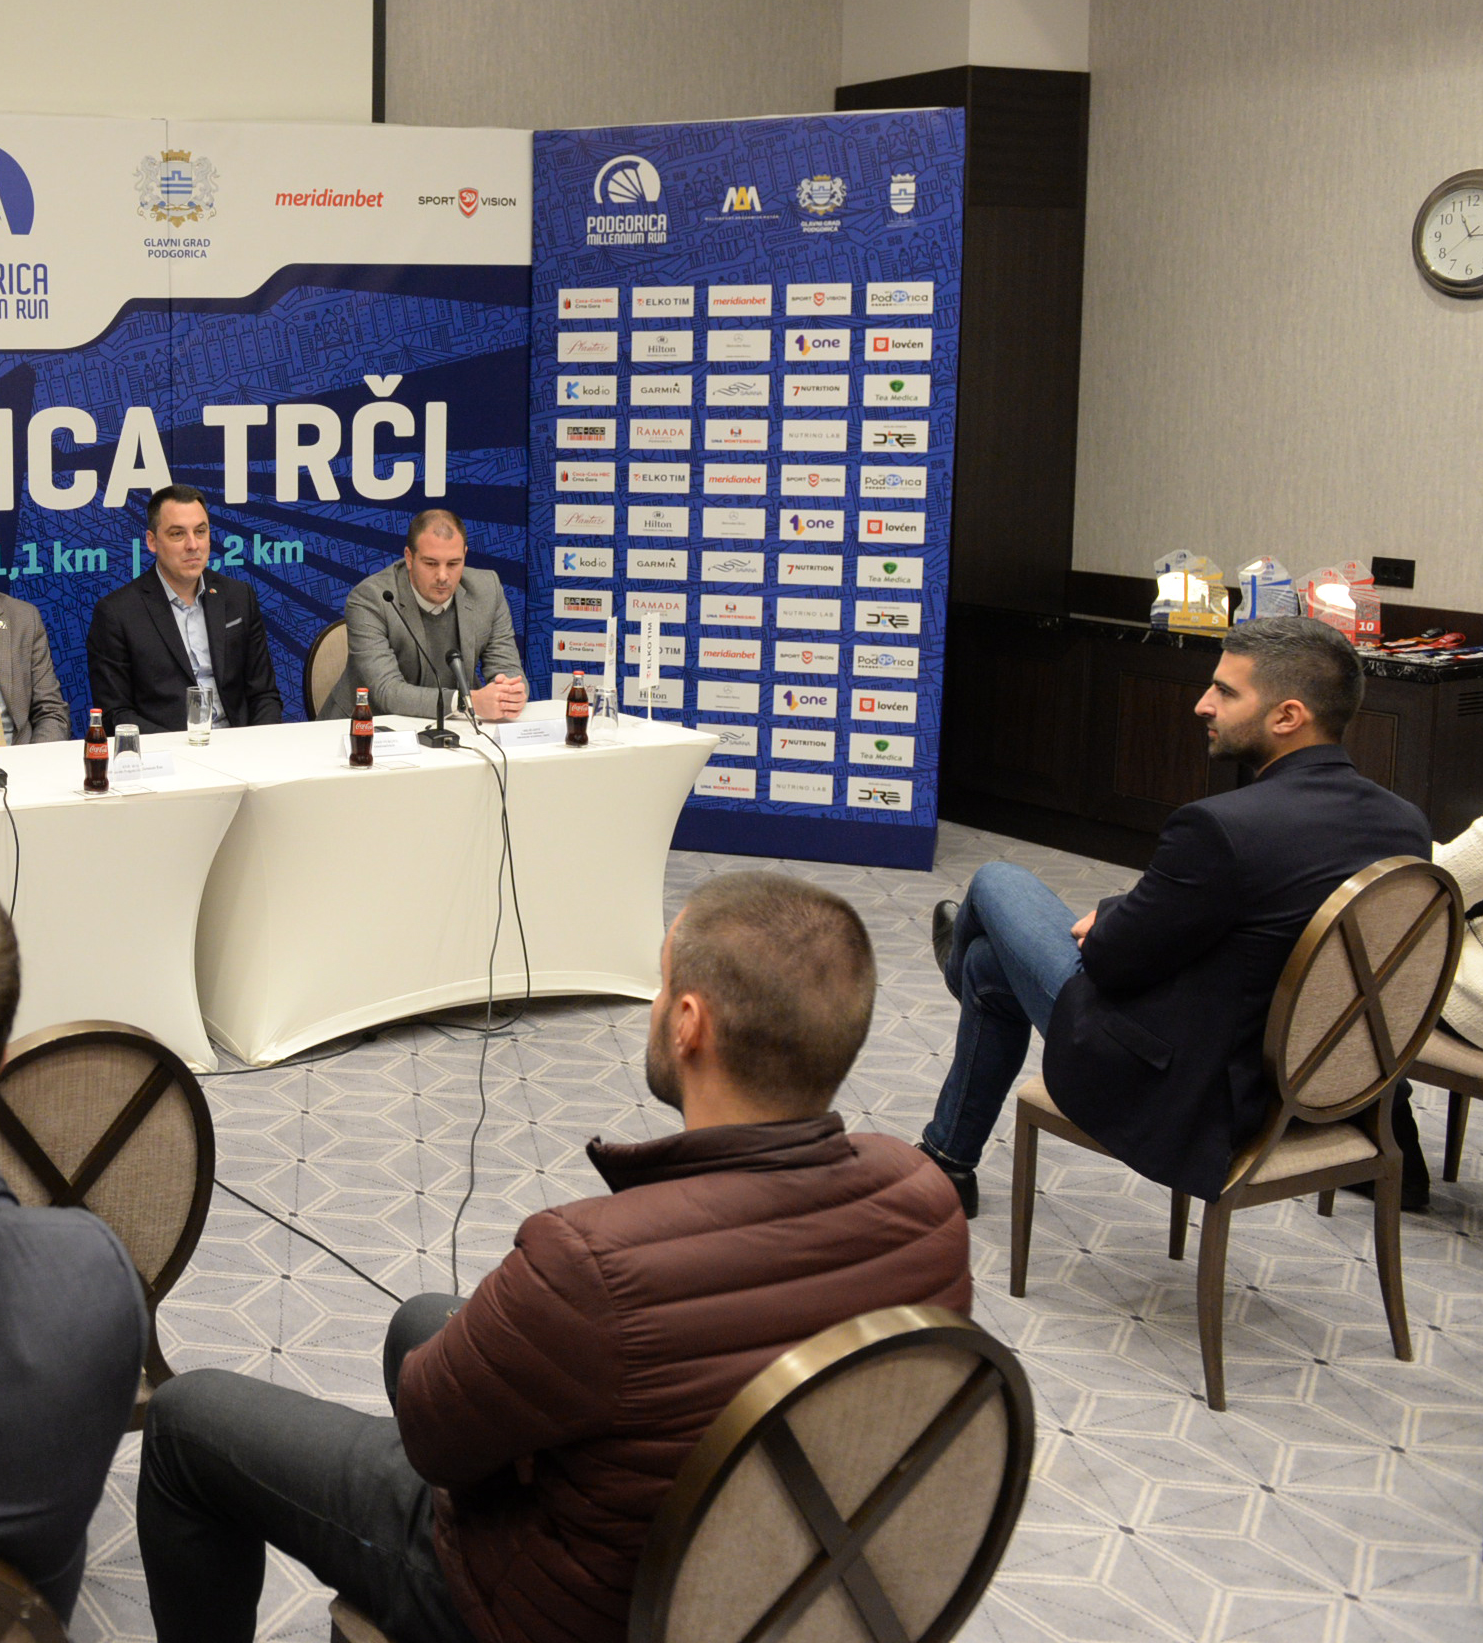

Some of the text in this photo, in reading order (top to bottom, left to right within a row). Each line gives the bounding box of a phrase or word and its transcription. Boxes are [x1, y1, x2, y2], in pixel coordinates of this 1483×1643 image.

[275, 189, 384, 208] meridianbet
[418, 196, 516, 206] SPORT VISION
[1468, 194, 1480, 206] 12
[1452, 200, 1463, 212] 11
[587, 215, 666, 232] PODGORICA
[1440, 214, 1453, 226] 10
[587, 232, 666, 245] MILLENNIUM RUN
[1434, 231, 1442, 242] 9
[144, 238, 211, 248] GLAVNI GRAD
[148, 249, 207, 259] PODGORICA
[1438, 248, 1446, 259] 8
[1450, 259, 1457, 270] 7
[1465, 264, 1473, 276] 6
[646, 298, 672, 306] ELKO
[713, 296, 766, 305] meridianbet
[16, 298, 49, 320] RUN
[648, 345, 676, 354] Hilton
[892, 340, 924, 349] lovćen
[636, 426, 684, 436] RAMADA
[203, 374, 447, 504] TRČI
[642, 474, 668, 482] ELKO
[709, 476, 761, 484] meridianbet
[644, 520, 672, 529] Hilton
[885, 522, 916, 532] lovćen
[54, 541, 108, 573] km
[254, 534, 304, 565] km
[637, 560, 676, 568] GARMIN
[632, 599, 680, 610] RAMADA
[1212, 616, 1219, 624] 5
[1358, 622, 1374, 632] 10
[704, 650, 756, 659] meridianbet
[877, 700, 909, 712] lovćen
[875, 752, 902, 762] Medica
